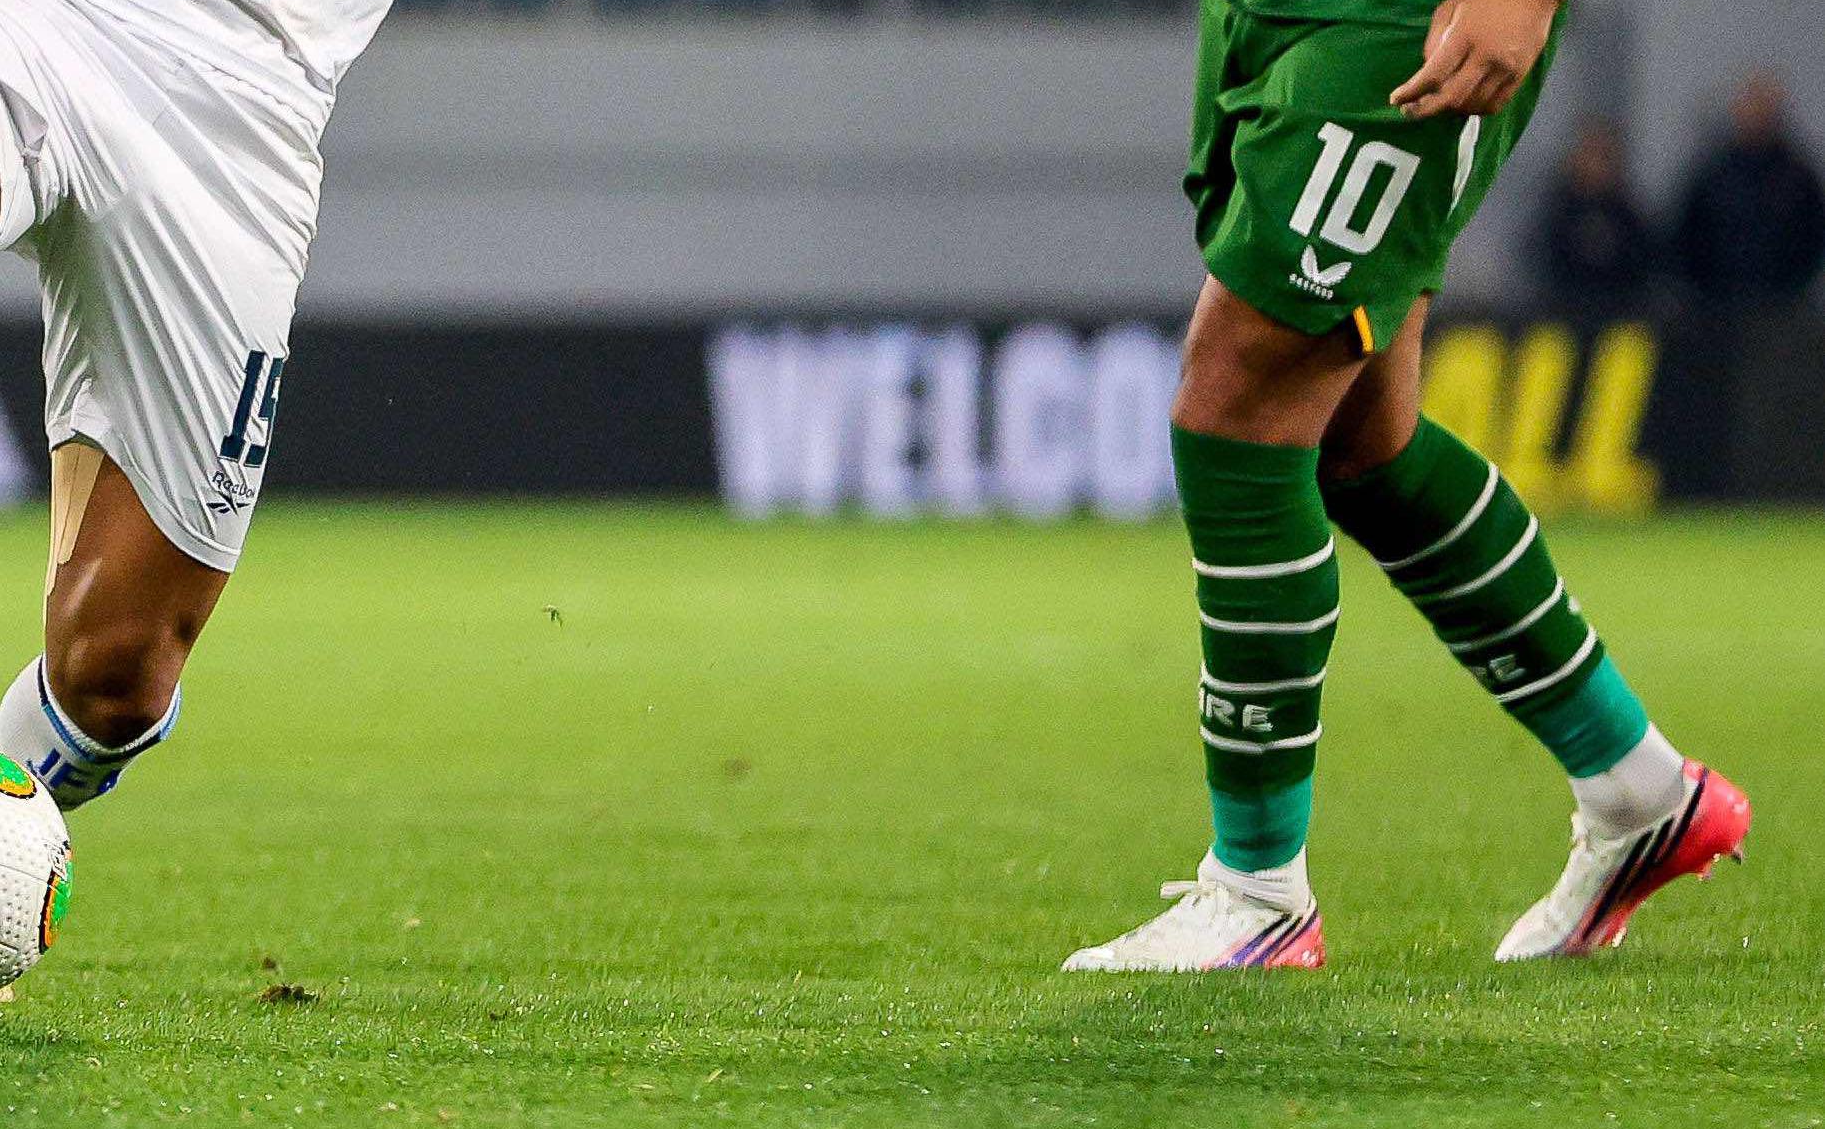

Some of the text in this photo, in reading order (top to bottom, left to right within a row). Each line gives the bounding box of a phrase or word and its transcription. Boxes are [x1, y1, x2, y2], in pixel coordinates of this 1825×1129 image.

[1289, 121, 1422, 255] 10
[218, 349, 285, 469] 15
[707, 323, 1179, 519] WELCO
[212, 470, 256, 498] Reebo
[1198, 687, 1274, 732] IRE
